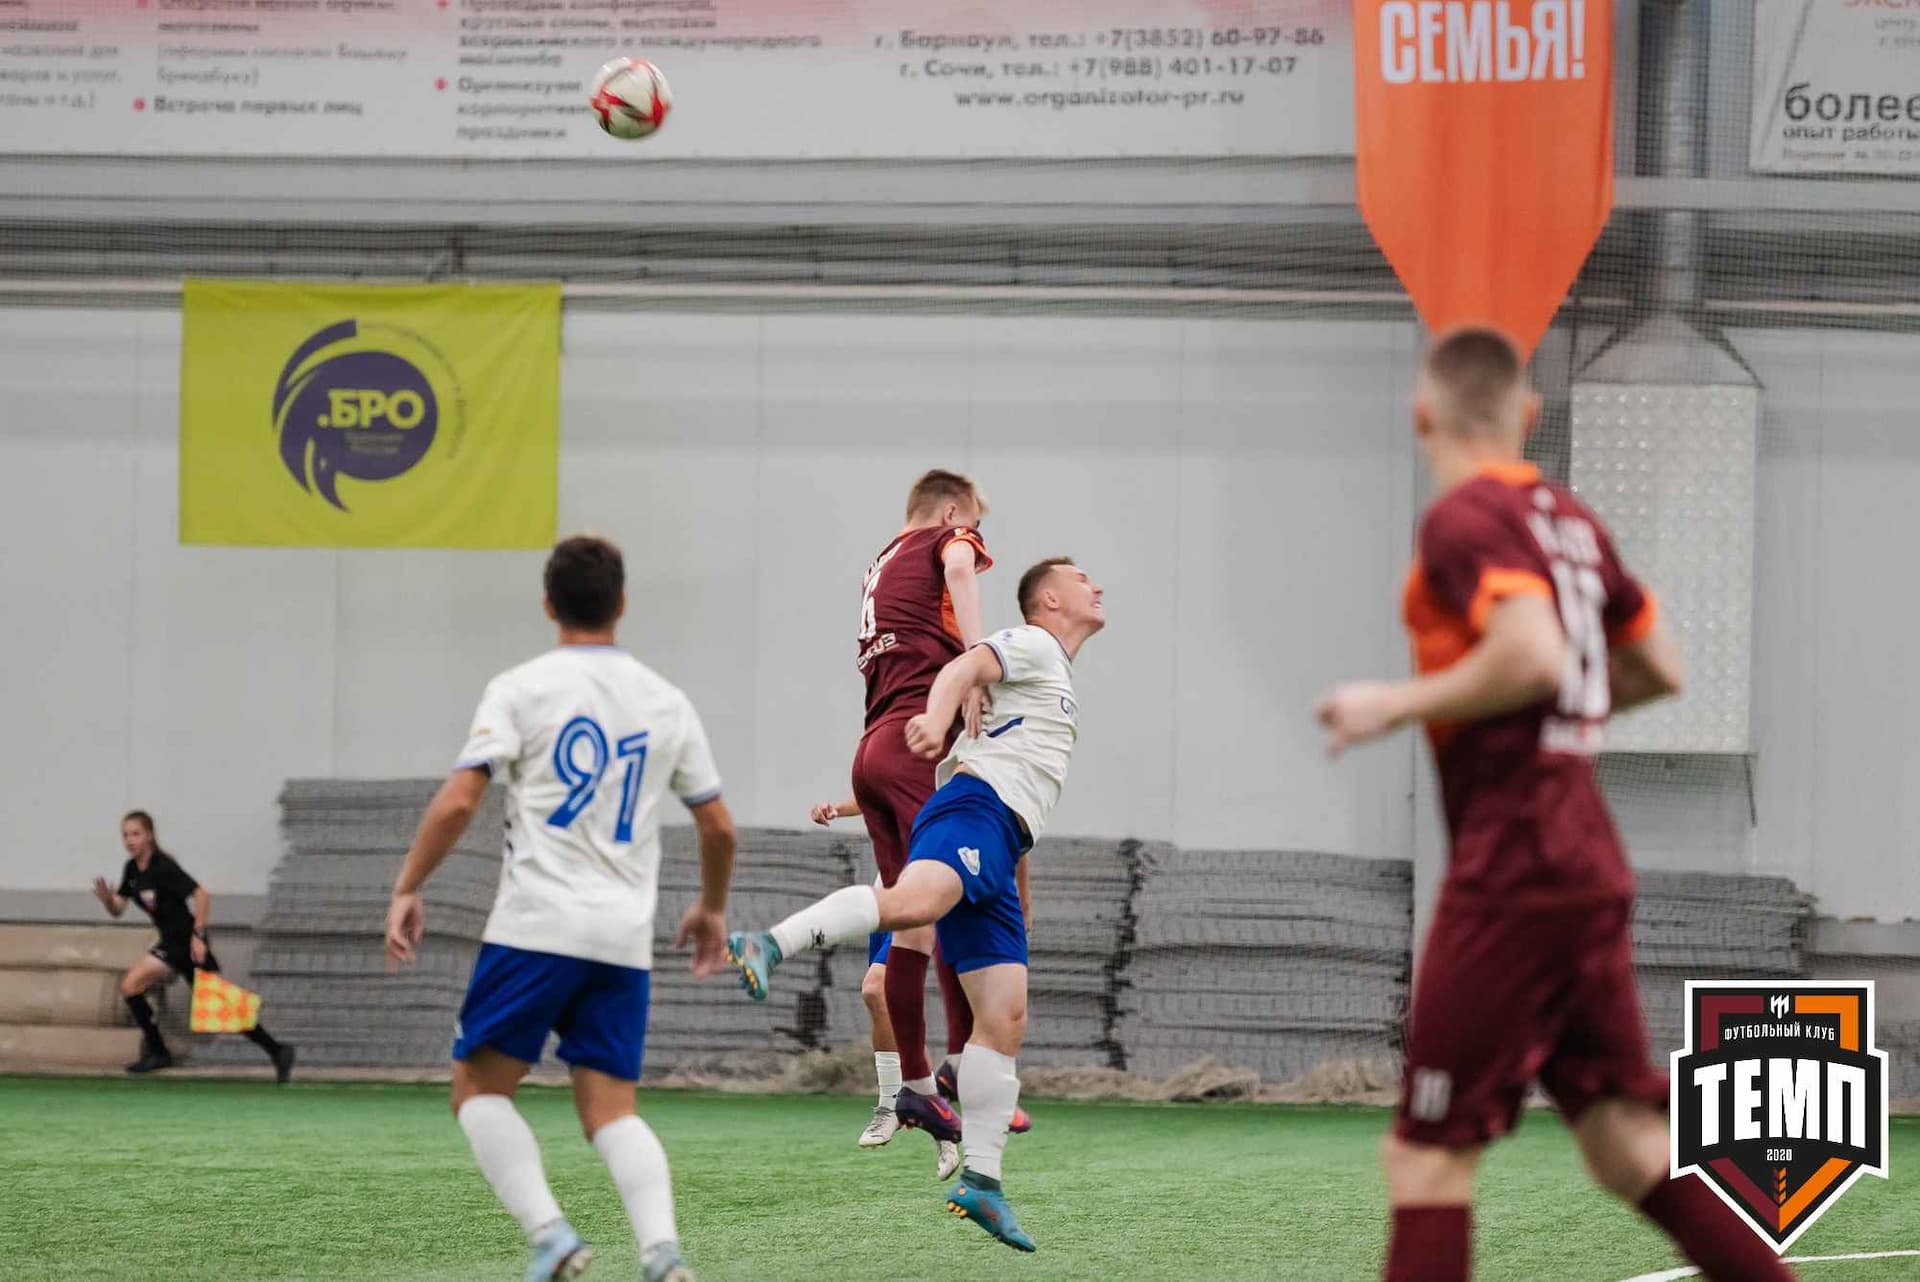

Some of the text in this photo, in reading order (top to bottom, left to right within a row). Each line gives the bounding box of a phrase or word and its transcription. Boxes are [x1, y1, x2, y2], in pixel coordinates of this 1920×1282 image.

[901, 31, 1019, 51] Барнаул,
[1096, 28, 1203, 51] +7(3852)
[1210, 27, 1325, 46] 60-97-86
[1379, 0, 1585, 84] СЕМЬЯ!
[924, 59, 994, 79] Сочи,
[1069, 57, 1162, 79] +7(988)
[1168, 56, 1297, 76] 401-17-07
[1785, 81, 1920, 121] более
[317, 388, 424, 430] .БРО
[547, 714, 650, 843] 91
